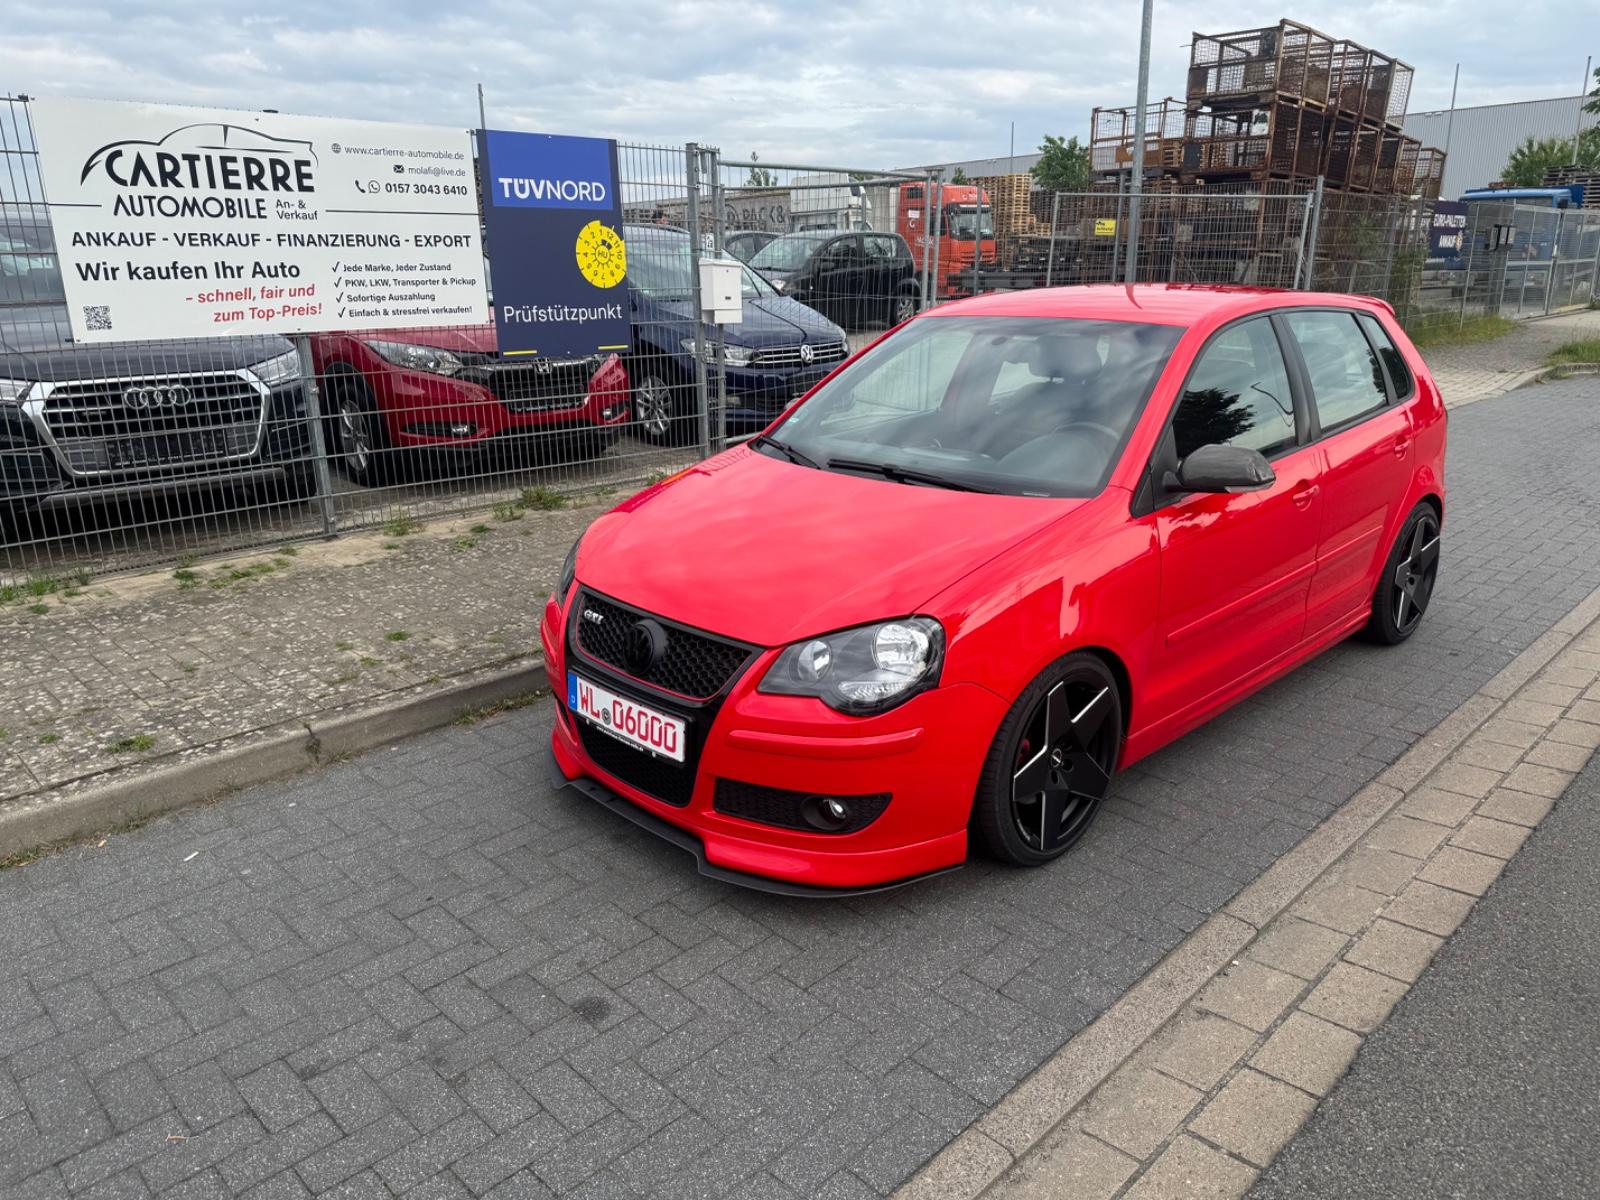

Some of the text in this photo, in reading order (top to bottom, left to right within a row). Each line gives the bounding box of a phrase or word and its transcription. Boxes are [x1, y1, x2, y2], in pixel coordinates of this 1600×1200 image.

[344, 146, 465, 160] www.cartierre-automobile.de
[104, 149, 315, 192] CARTIERRE
[385, 183, 468, 196] 0157 3043 6410
[113, 194, 267, 219] AUTOMOBILE
[275, 199, 306, 209] An- &
[276, 210, 318, 220] Verkauf
[72, 232, 157, 247] ANKAUF
[174, 232, 261, 247] VERKAUF
[277, 233, 400, 247] FINANZIERUNG
[414, 235, 472, 248] EXPORT
[75, 261, 301, 281] Wir kaufen Ihr Auto
[343, 263, 452, 272] Jede Marke, Jeder Zustand
[345, 277, 476, 288] PKW, LKW, Transporter & Pickup
[197, 286, 256, 303] schnell,
[260, 285, 285, 299] fair
[288, 284, 315, 298] und
[347, 292, 436, 303] Sofortige Auszahlung
[213, 303, 323, 323] zum Top-Preis!
[349, 306, 472, 318] Einfach & stressfrei verkaufen!
[503, 303, 623, 325] Prüfstützpunkt
[583, 609, 604, 625] GTI
[579, 682, 600, 720] WL
[612, 699, 677, 753] 06000
